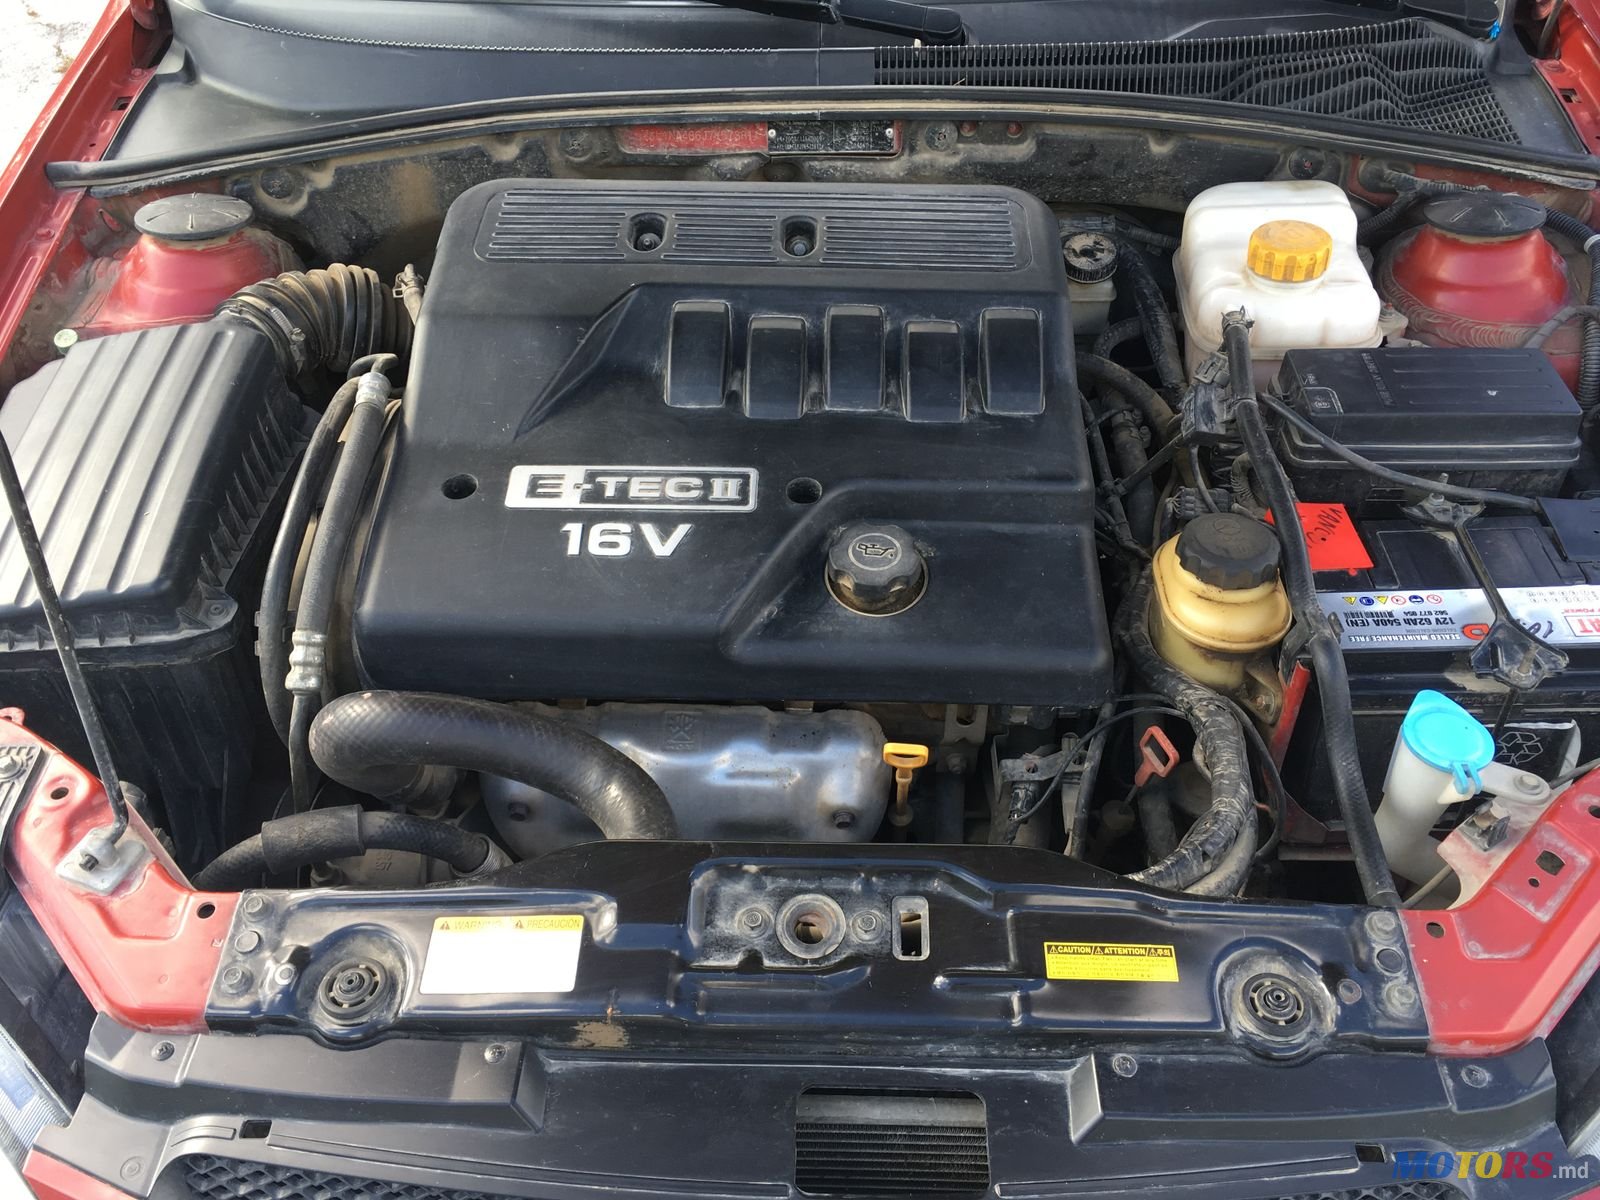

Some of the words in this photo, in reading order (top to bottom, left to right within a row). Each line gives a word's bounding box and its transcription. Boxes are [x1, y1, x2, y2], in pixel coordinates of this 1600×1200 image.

[525, 473, 704, 500] E-TEC
[708, 477, 743, 501] II
[560, 522, 694, 557] 16V
[1345, 618, 1370, 627] (EN)
[1374, 618, 1402, 627] 540A
[1402, 617, 1433, 626] 62Ah
[1435, 617, 1456, 625] 12V
[1372, 633, 1429, 641] MAINTENANCE
[1430, 633, 1461, 641] SEALED
[1057, 945, 1092, 954] CAUTION
[1104, 946, 1146, 956] ATTENTION
